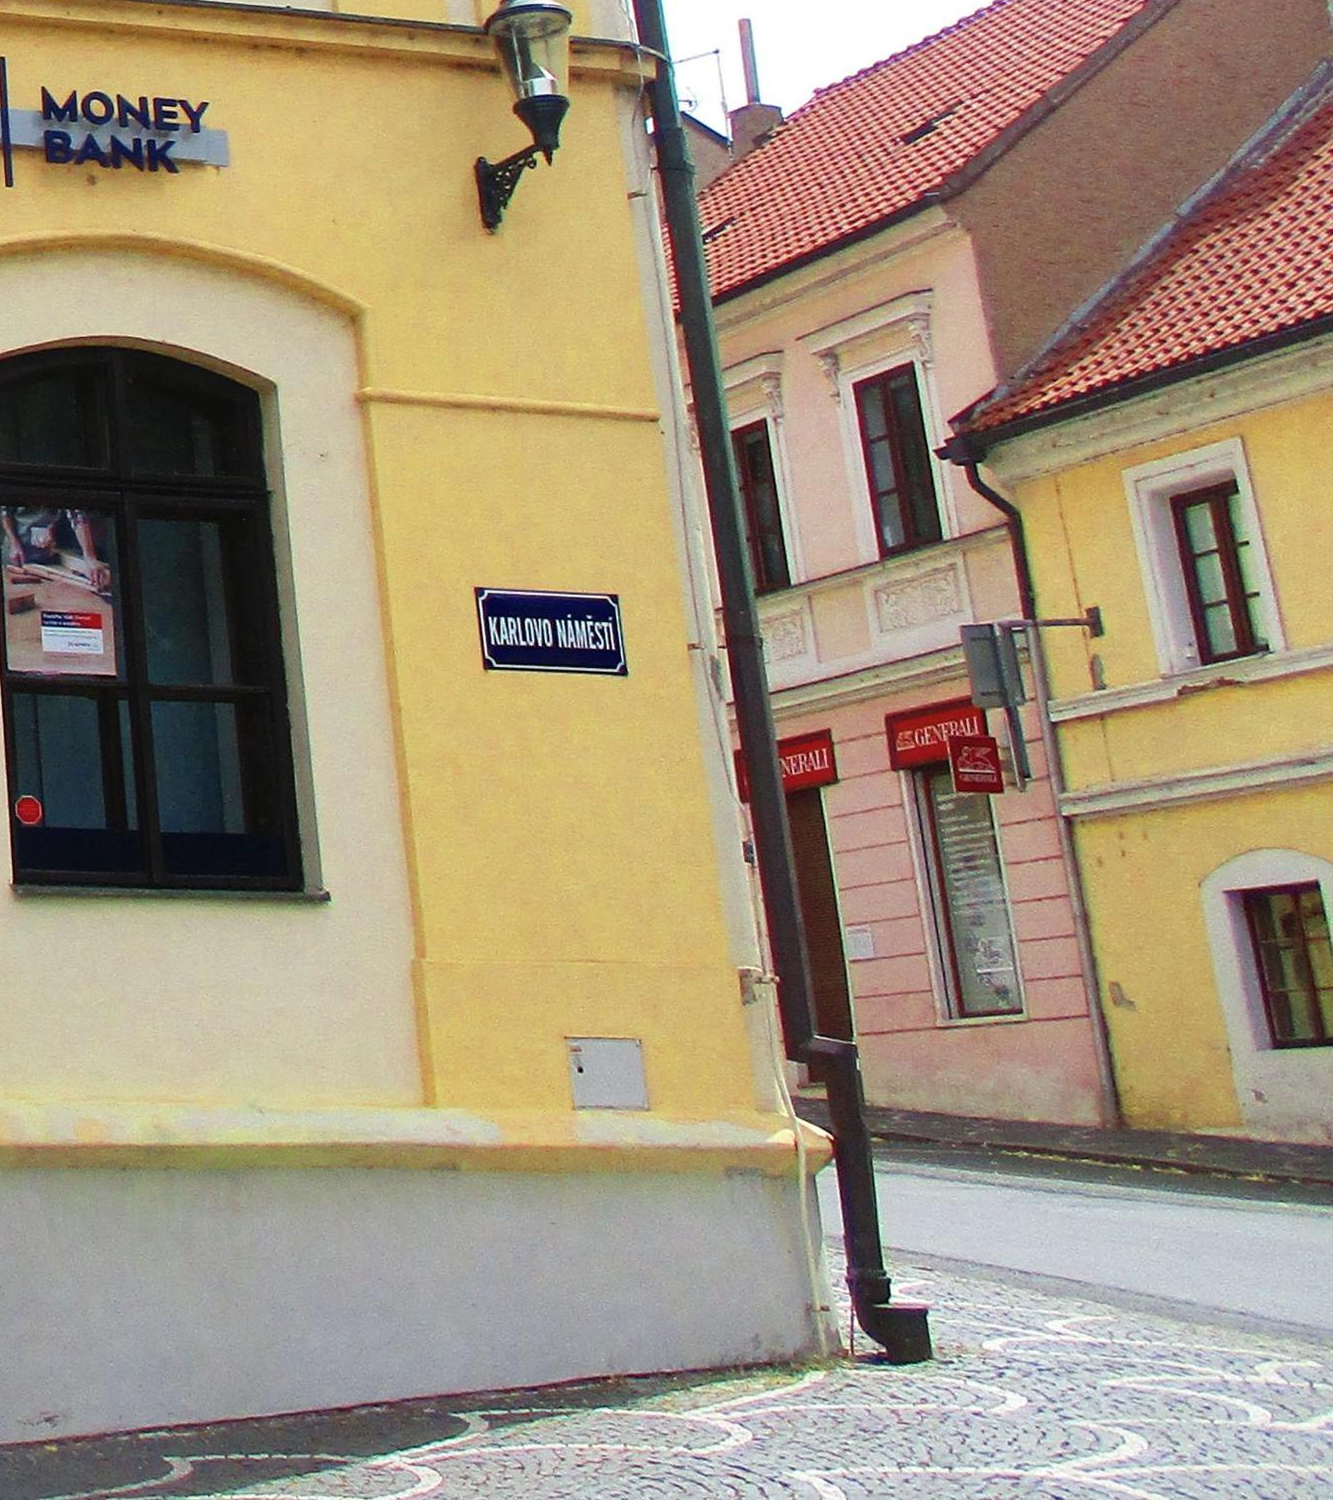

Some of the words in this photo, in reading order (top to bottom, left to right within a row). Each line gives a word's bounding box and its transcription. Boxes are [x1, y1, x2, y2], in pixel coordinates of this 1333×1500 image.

[40, 86, 210, 134] MONEY
[41, 130, 179, 174] BANK
[488, 616, 553, 647] KARLOVO
[555, 614, 616, 651] NÁMĚSTÍ
[914, 715, 980, 747] GENERALI
[779, 748, 829, 778] NERALI
